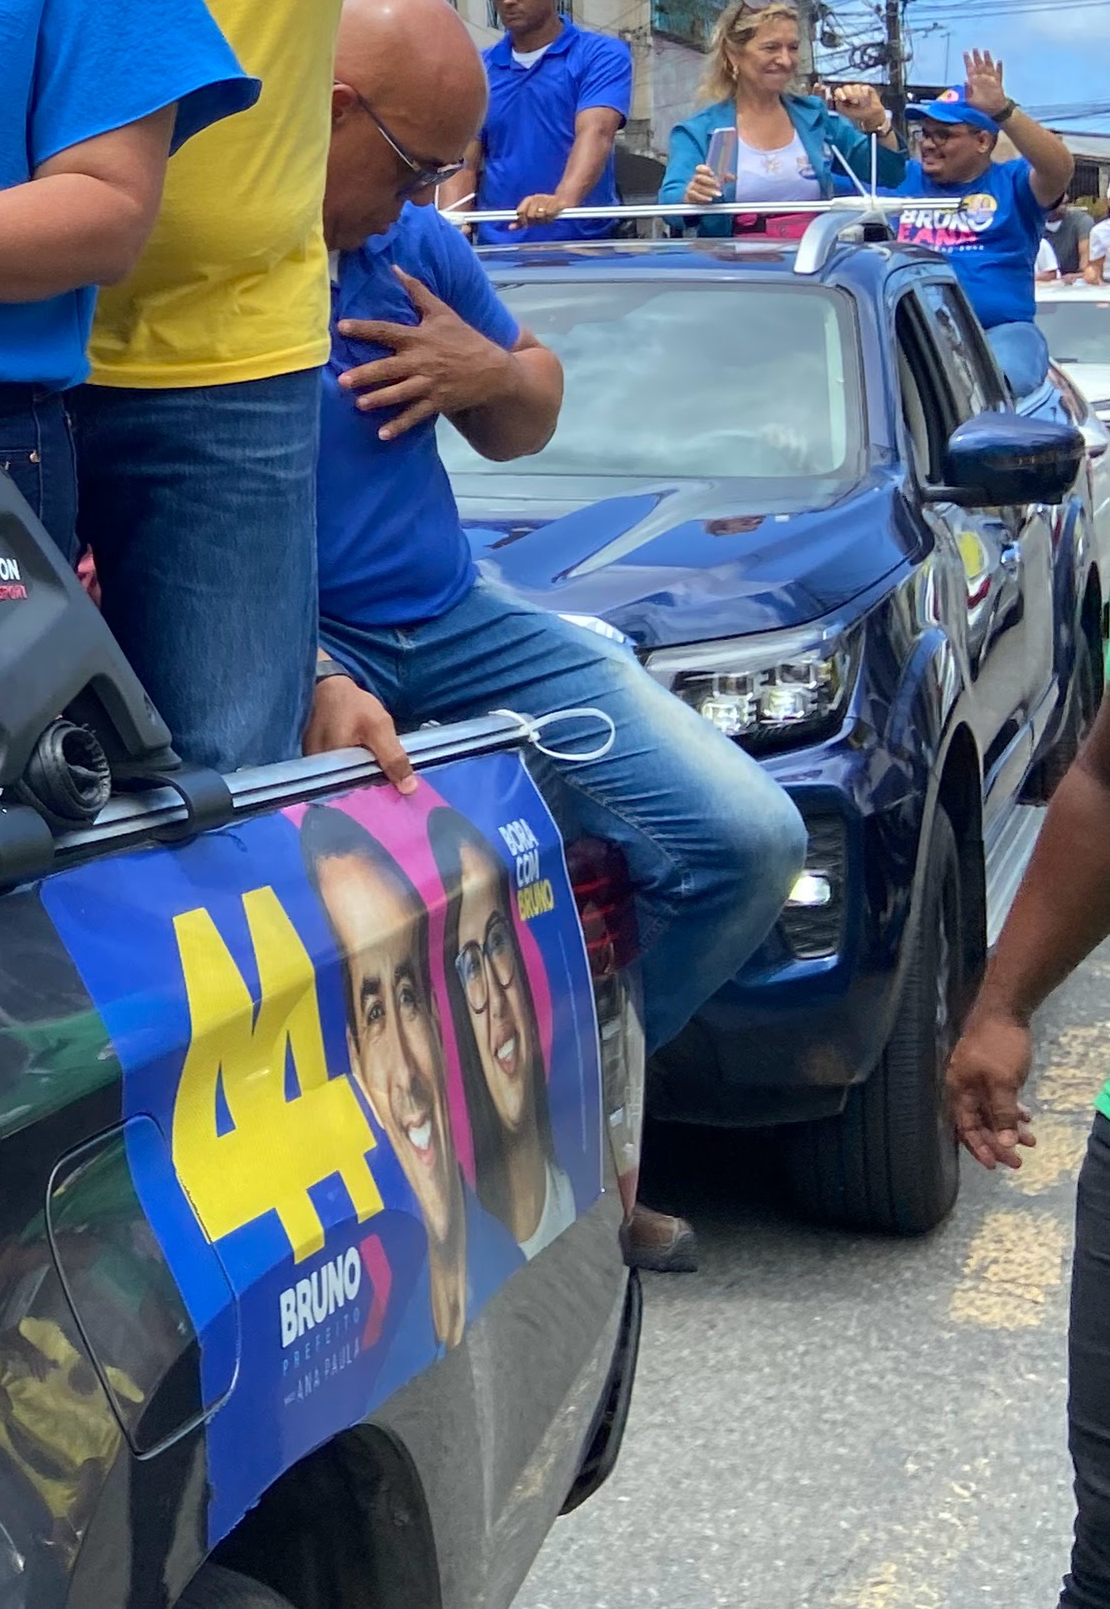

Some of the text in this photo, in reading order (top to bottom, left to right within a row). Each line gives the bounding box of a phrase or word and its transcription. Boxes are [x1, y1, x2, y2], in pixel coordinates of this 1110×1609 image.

[497, 818, 539, 856] BORA
[516, 849, 540, 888] COM
[517, 879, 554, 922] BRUNO
[171, 885, 385, 1265] 44
[279, 1246, 361, 1349] BRUNO
[282, 1306, 361, 1376] PREFEITO
[297, 1335, 360, 1402] ANA PAULA
